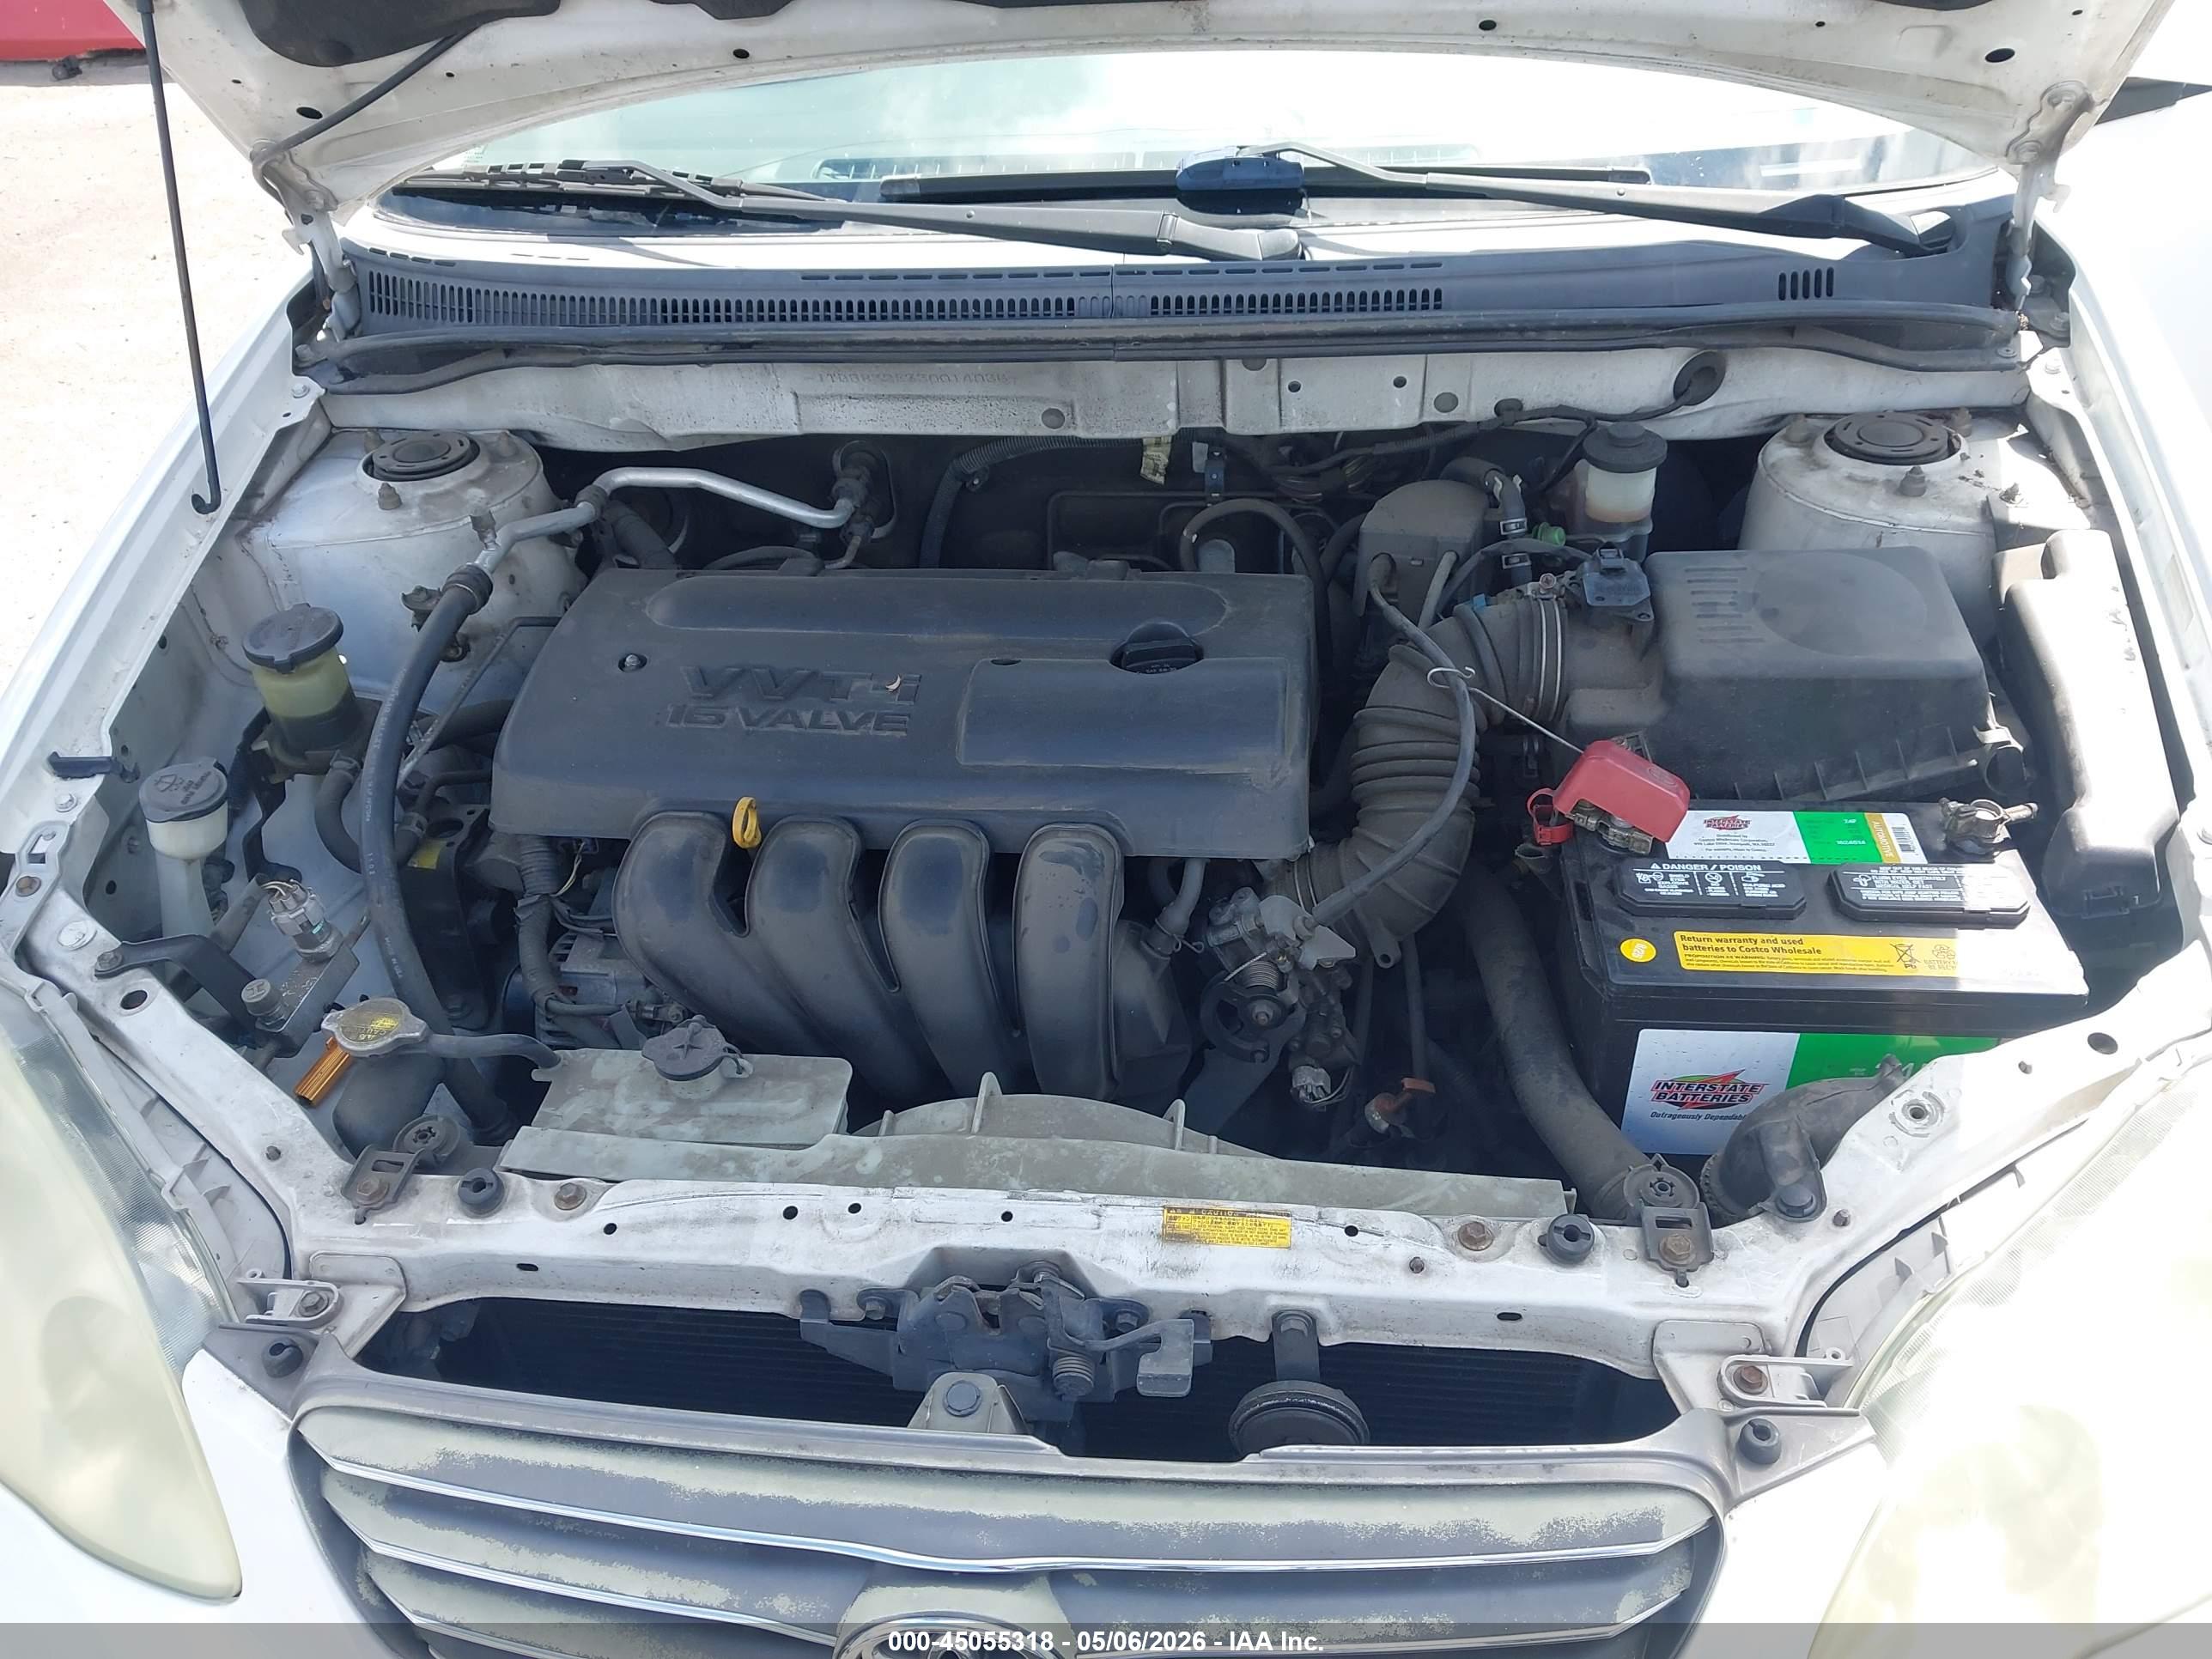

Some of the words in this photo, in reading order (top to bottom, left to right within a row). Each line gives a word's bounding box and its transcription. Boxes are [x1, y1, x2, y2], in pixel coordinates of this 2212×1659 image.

[666, 702, 729, 729] 16
[738, 706, 912, 737] VALVE
[1680, 934, 1713, 943] Return
[1715, 936, 1758, 945] warranty
[1682, 944, 1725, 952] batteries
[1771, 946, 1822, 955] Wholesale
[1654, 1080, 1763, 1094] INTERSTATE
[1654, 1092, 1752, 1103] BATTERIES
[1650, 1111, 1703, 1121] Outrageously
